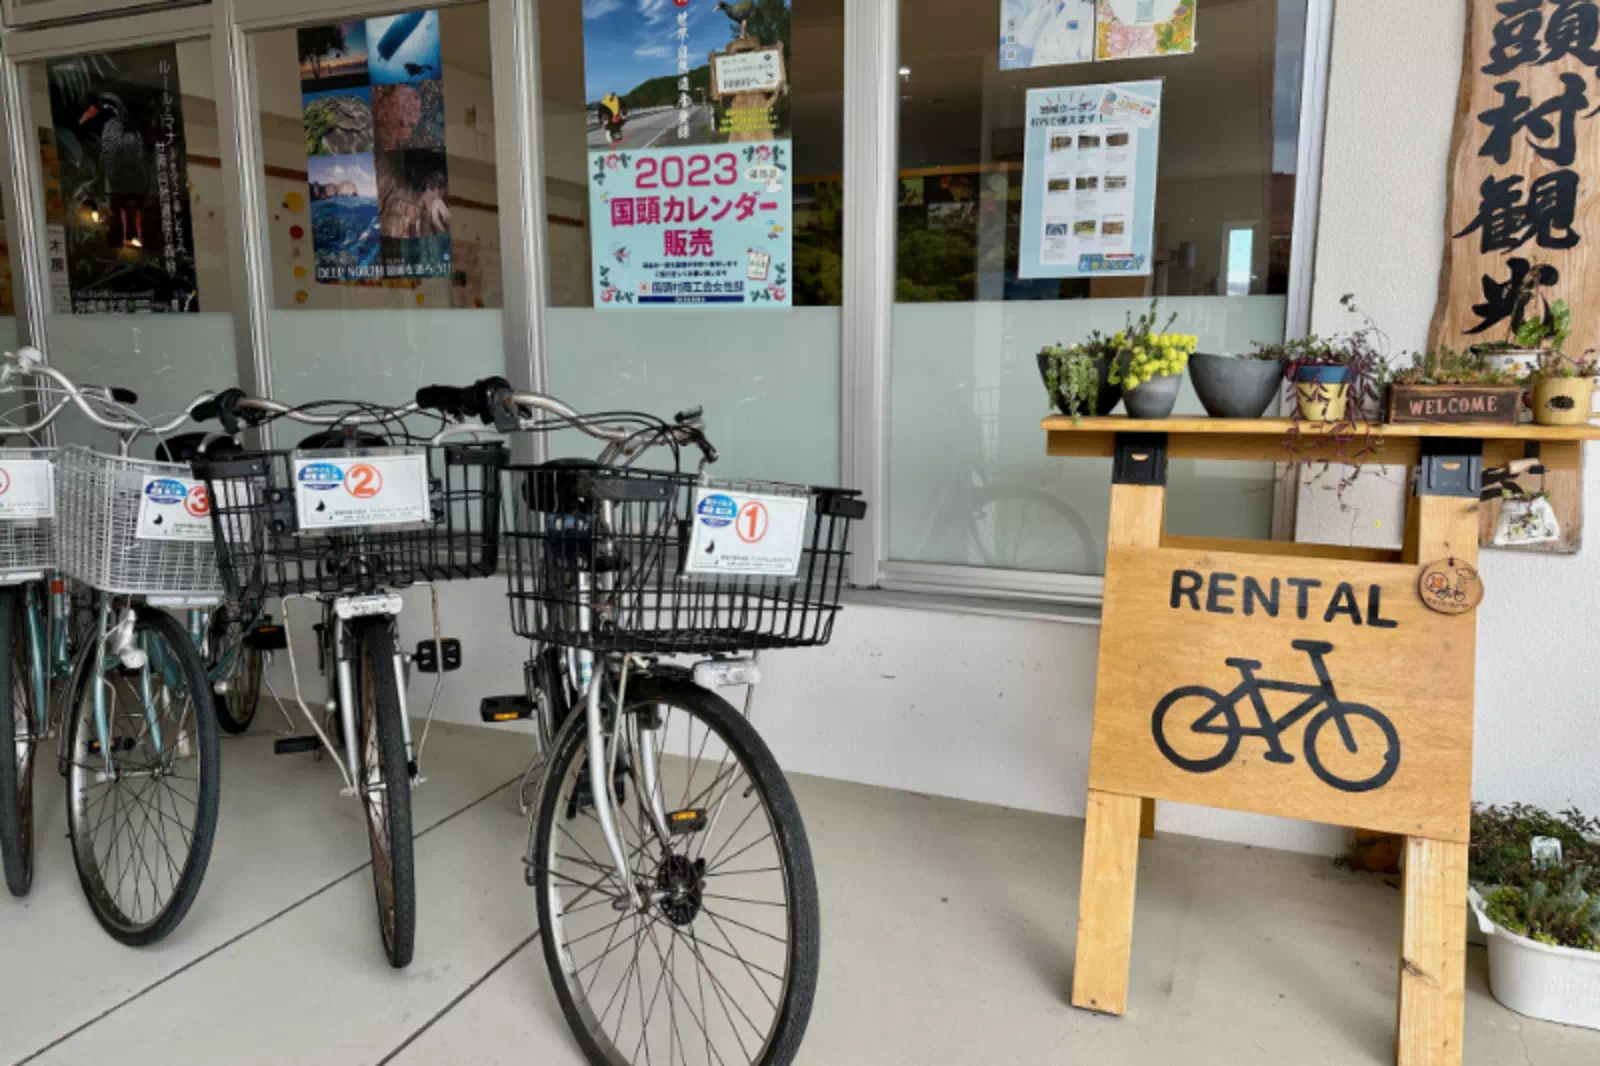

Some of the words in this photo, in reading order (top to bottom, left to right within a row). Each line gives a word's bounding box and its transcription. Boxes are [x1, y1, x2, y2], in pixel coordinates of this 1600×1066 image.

[635, 152, 738, 189] 2023
[611, 190, 778, 227] 国頭カレンダー
[663, 227, 713, 258] 販売
[1409, 395, 1499, 416] WELCOME
[1170, 569, 1399, 629] RENTAL
